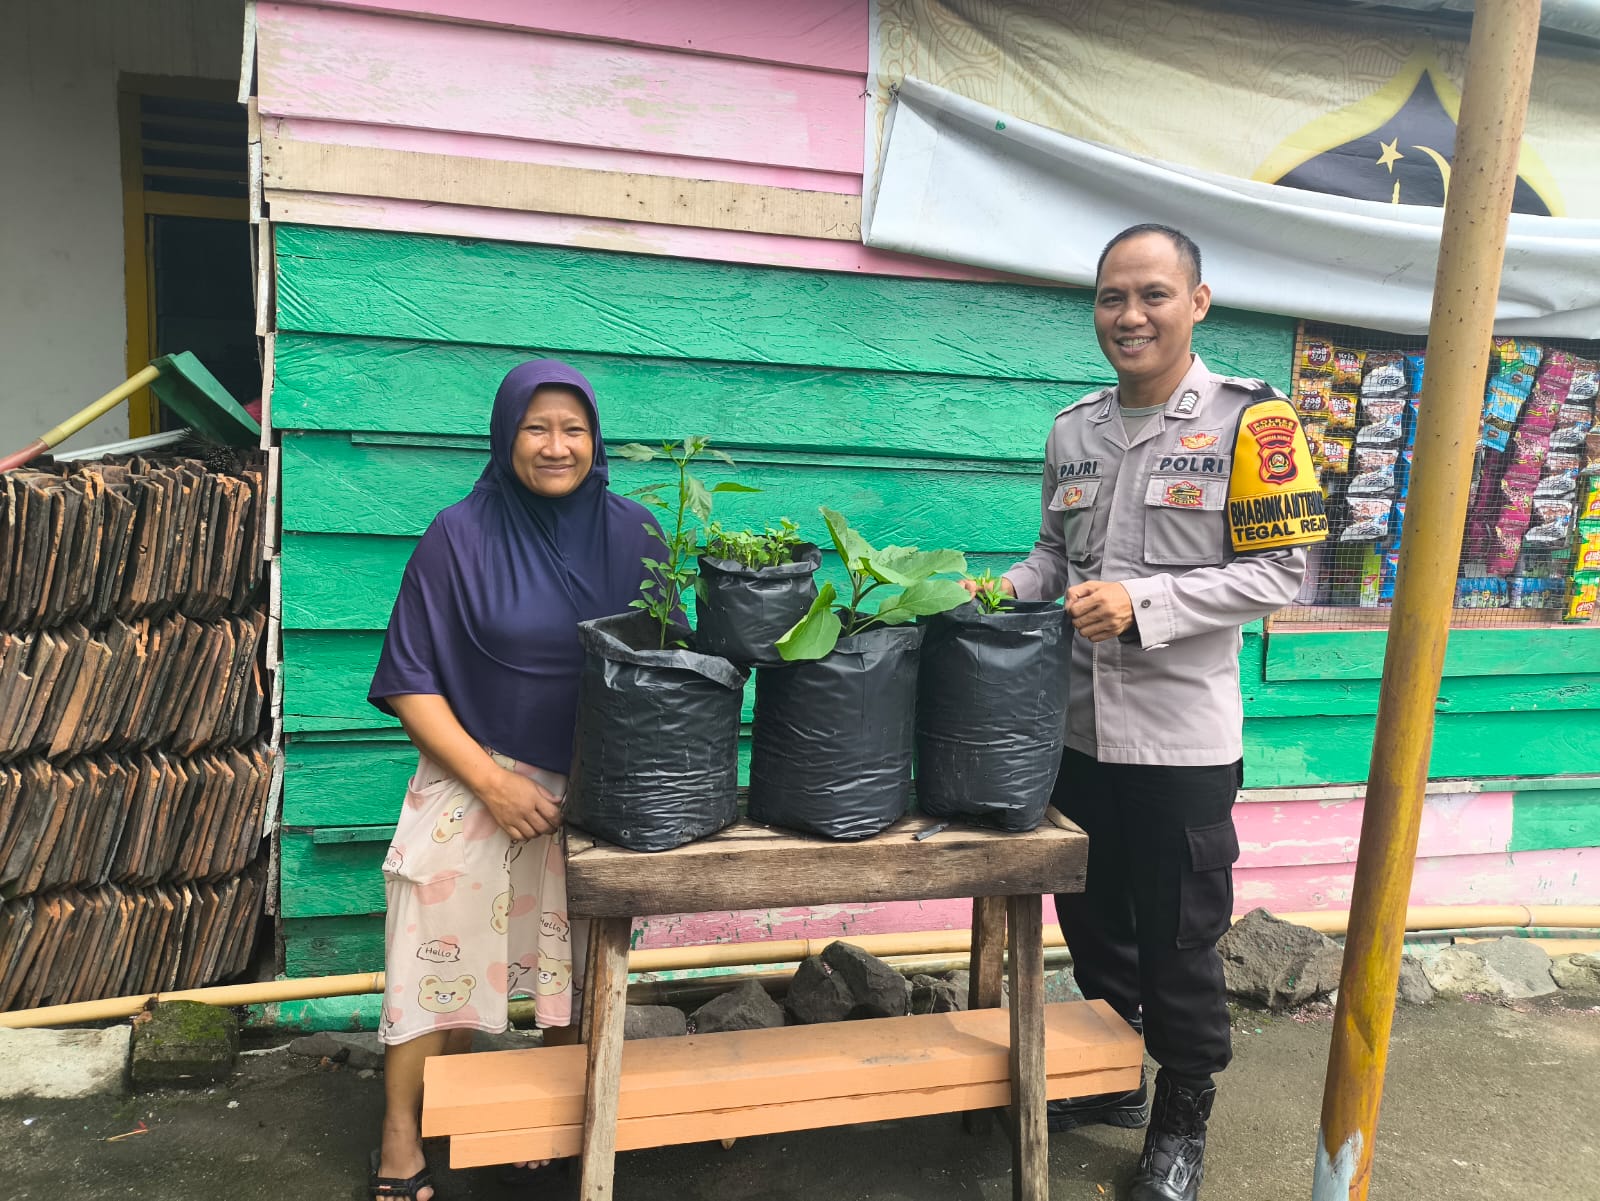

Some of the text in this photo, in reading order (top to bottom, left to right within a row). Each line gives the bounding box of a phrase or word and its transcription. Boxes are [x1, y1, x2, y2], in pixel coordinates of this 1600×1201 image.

[1060, 461, 1098, 478] PAJRI
[1160, 457, 1224, 473] POLRI
[1234, 516, 1328, 543] TEGAL REJO
[425, 948, 452, 958] Hello
